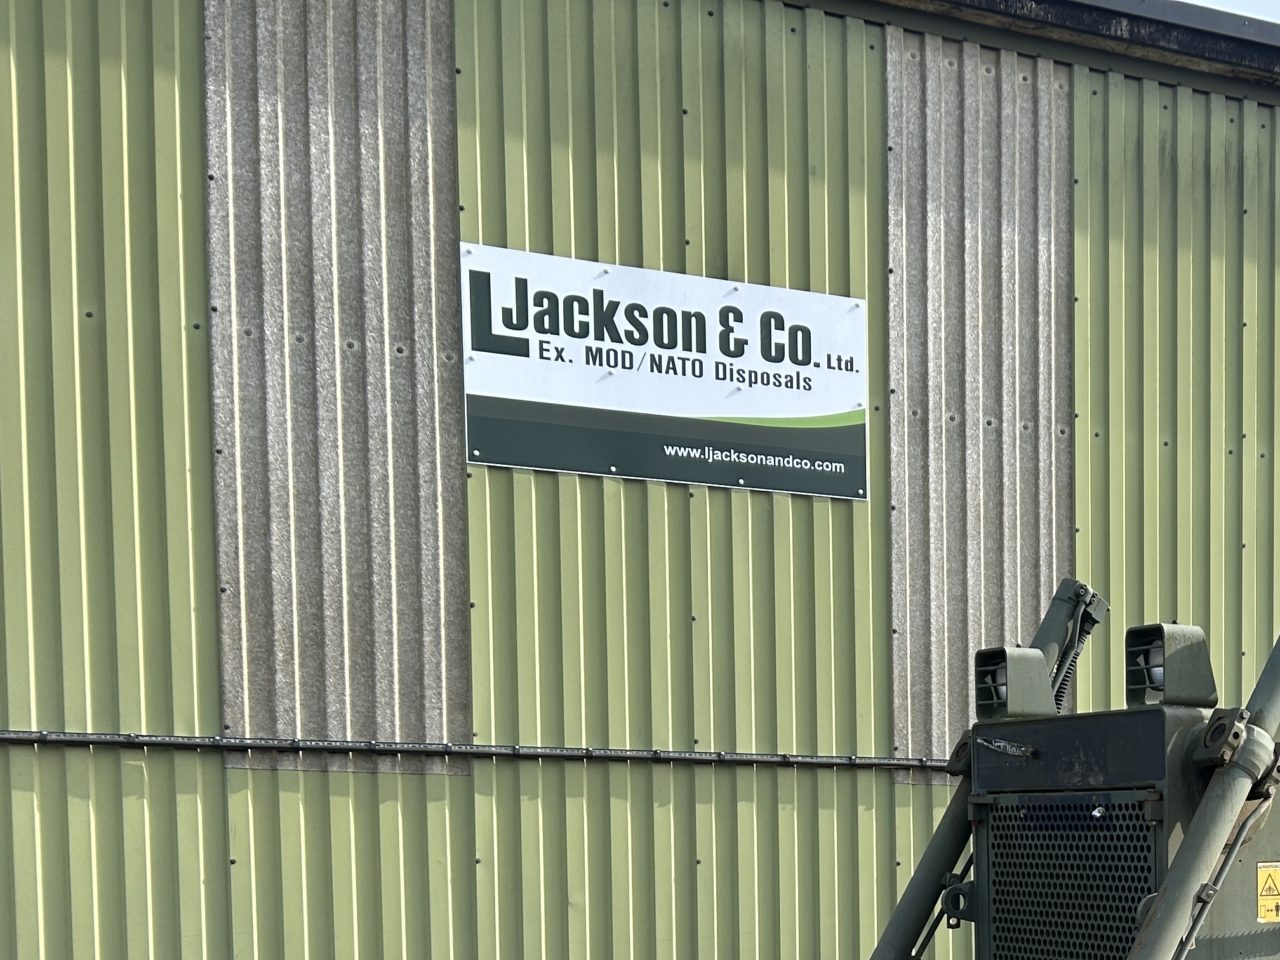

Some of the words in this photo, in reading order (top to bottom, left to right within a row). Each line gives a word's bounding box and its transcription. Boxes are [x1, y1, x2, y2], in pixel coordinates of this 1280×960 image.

[538, 339, 574, 364] Ex.
[584, 345, 704, 379] MOD/NATO
[714, 361, 813, 391] Disposals
[718, 305, 749, 359] &
[759, 310, 821, 368] Co.
[826, 353, 860, 373] Ltd.
[663, 444, 845, 473] www.ljacksonandco.com
